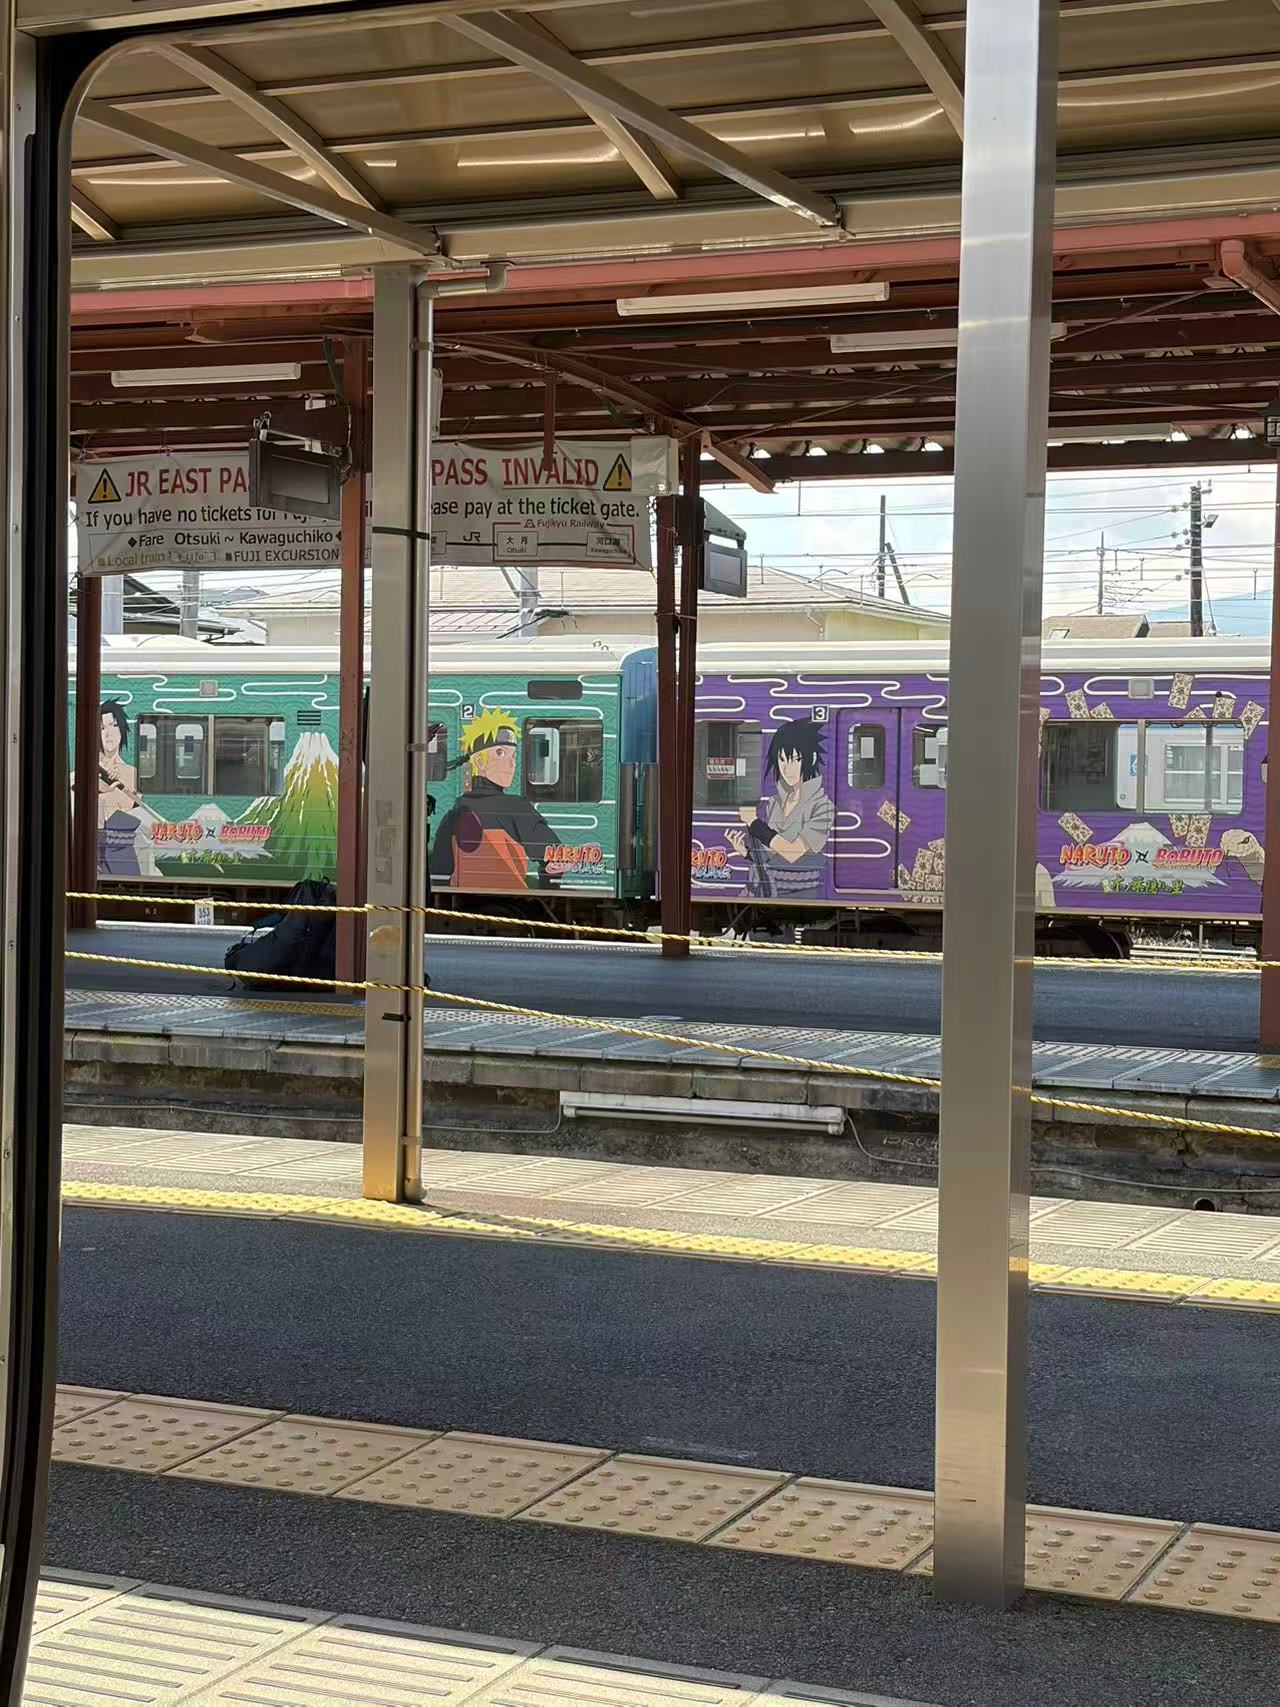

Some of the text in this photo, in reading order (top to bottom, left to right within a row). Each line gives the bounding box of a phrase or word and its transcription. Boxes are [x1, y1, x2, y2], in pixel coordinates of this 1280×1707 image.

[125, 457, 599, 497] JR EAST PA PASS INVALID
[86, 511, 99, 527] If
[104, 513, 132, 530] you
[138, 507, 172, 524] have
[178, 510, 197, 522] no
[201, 505, 251, 522] tickets
[465, 502, 492, 519] pay
[497, 499, 513, 515] at
[519, 498, 545, 515] the
[551, 497, 597, 515] ticket
[600, 501, 640, 520] gate.
[537, 518, 605, 529] Fujikyu Railway
[139, 533, 164, 547] Fare
[174, 532, 220, 546] Otsuki
[240, 530, 333, 547] Kawaguchiko
[463, 531, 481, 542] JR
[506, 535, 528, 545] 大月
[107, 553, 138, 567] Local
[141, 552, 165, 565] train
[234, 548, 340, 562] FUJI EXCURSION
[462, 705, 474, 718] 2
[815, 707, 826, 721] 3
[544, 844, 602, 863] NARUTO
[691, 850, 727, 868] RUTO
[1060, 845, 1131, 867] NARUTO
